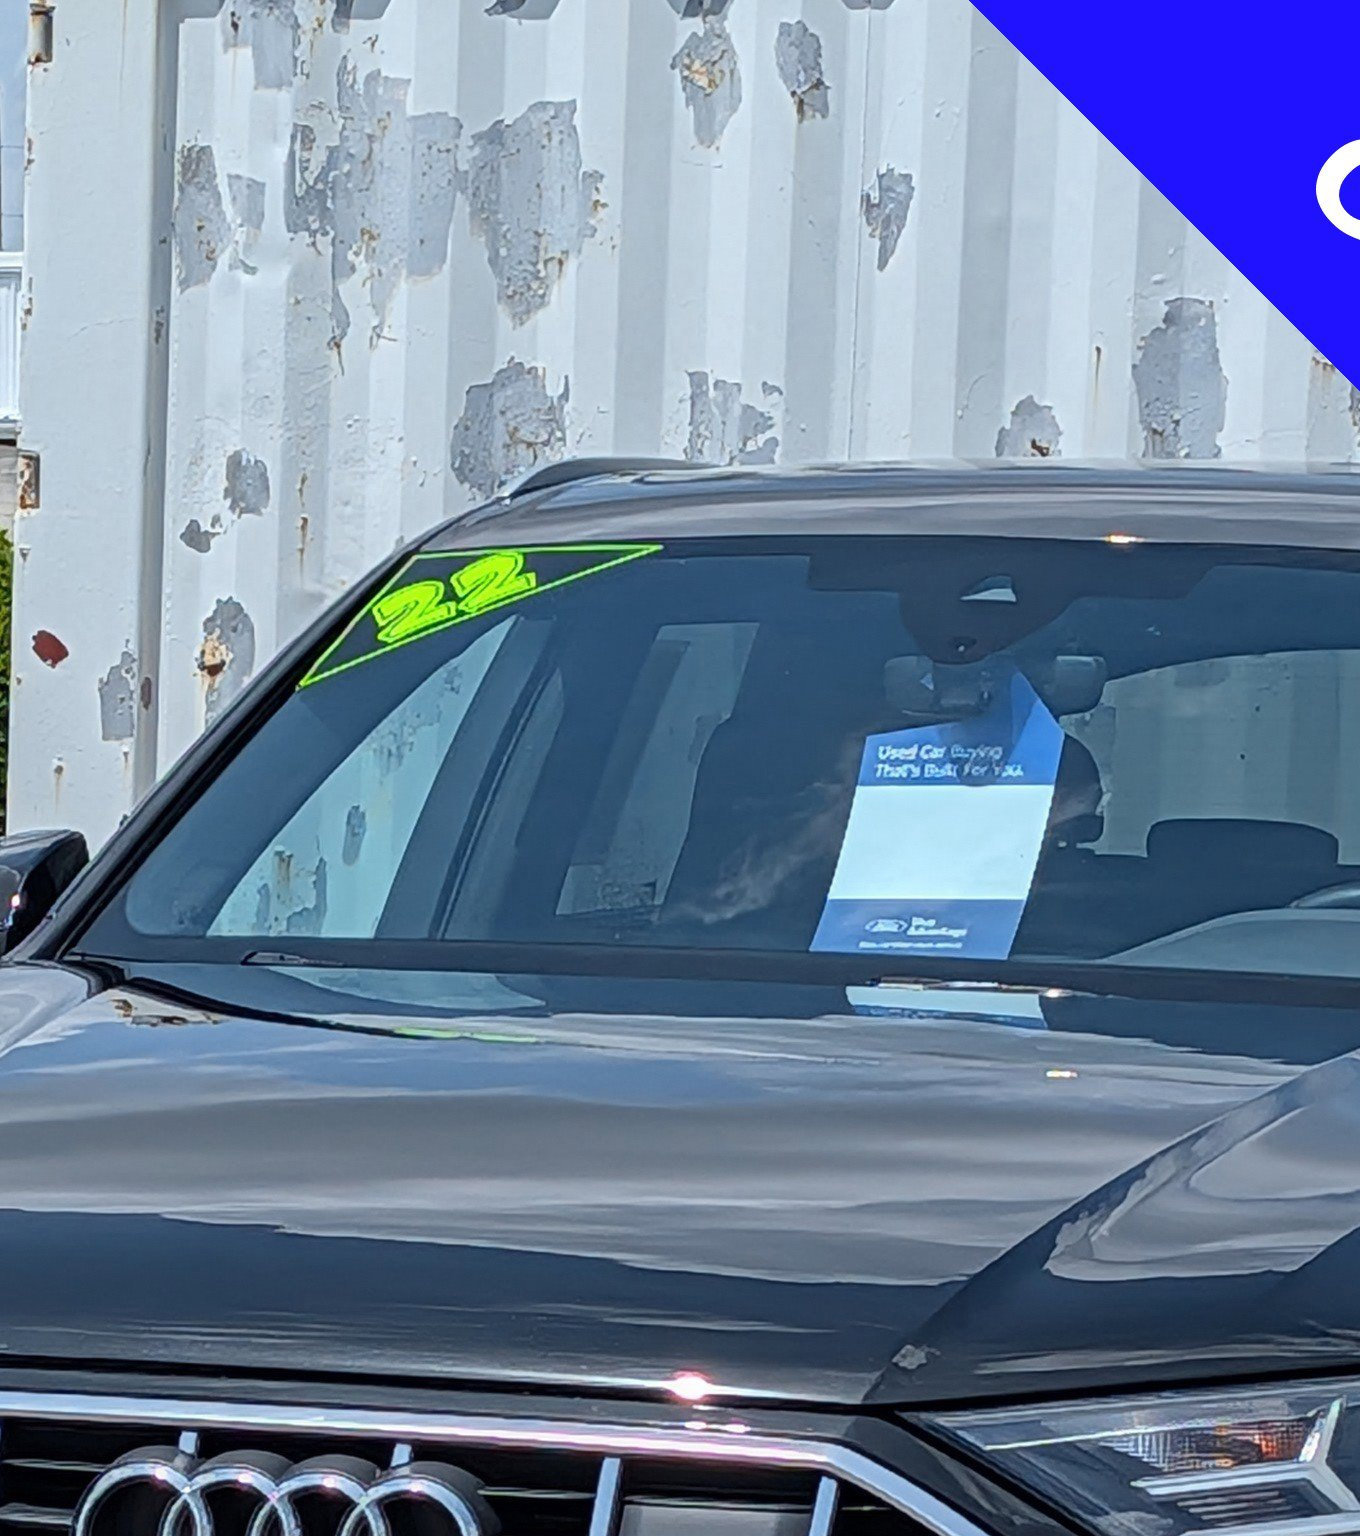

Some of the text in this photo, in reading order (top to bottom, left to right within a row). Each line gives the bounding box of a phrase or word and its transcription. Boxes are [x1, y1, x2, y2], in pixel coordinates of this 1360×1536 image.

[372, 551, 537, 643] 22
[878, 743, 919, 760] Used
[920, 744, 946, 760] Car
